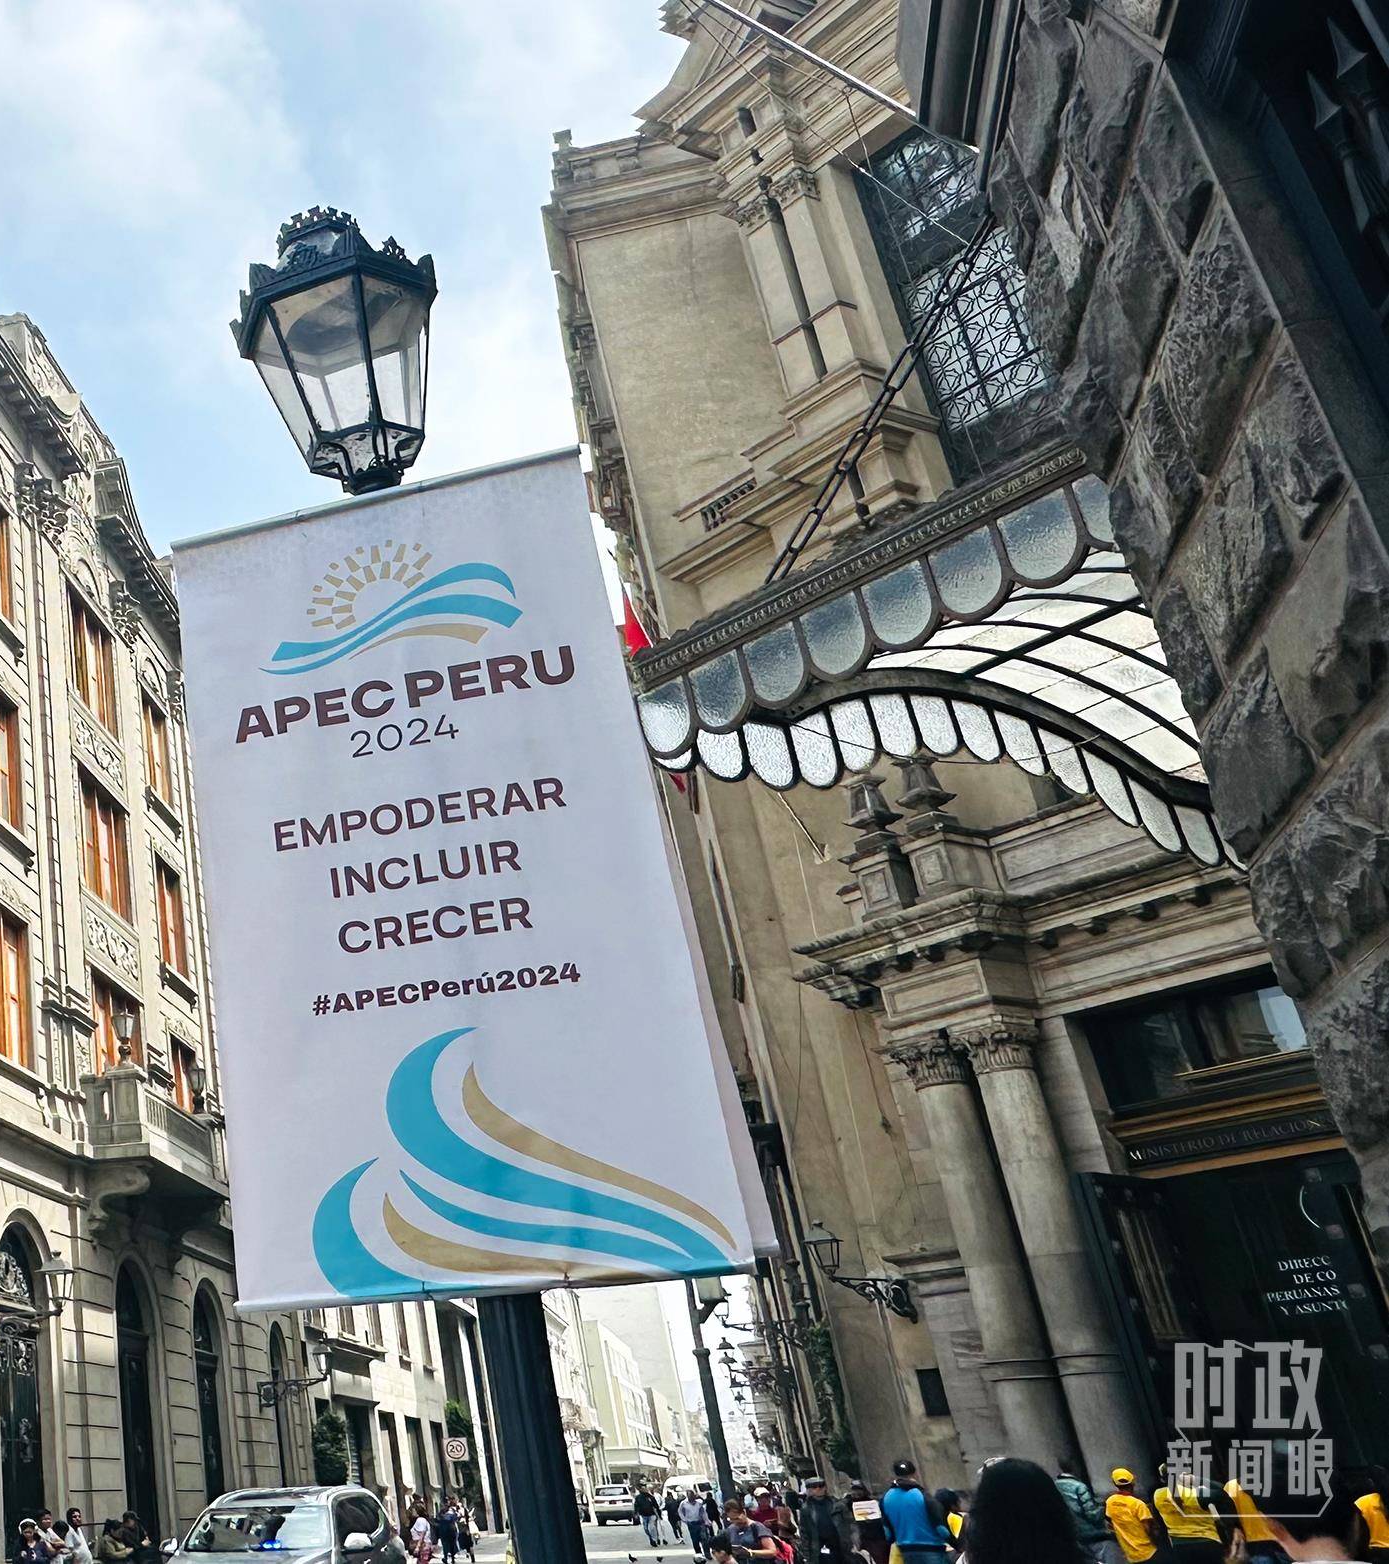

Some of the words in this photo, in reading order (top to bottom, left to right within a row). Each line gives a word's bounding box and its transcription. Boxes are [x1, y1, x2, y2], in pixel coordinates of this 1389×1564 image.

[235, 680, 396, 744] APEC
[404, 645, 576, 708] PERU
[350, 714, 460, 758] 2024
[274, 777, 567, 852] EMPODERAR
[330, 840, 522, 898] INCLUIR
[337, 897, 533, 954] CRECER
[312, 962, 581, 1017] #APECPerú2024
[1129, 1135, 1214, 1161] MINISTERIO
[1218, 1132, 1237, 1146] DE
[1267, 1284, 1340, 1302] PERUANAS
[1293, 1272, 1314, 1284] DE
[449, 1444, 463, 1453] 20
